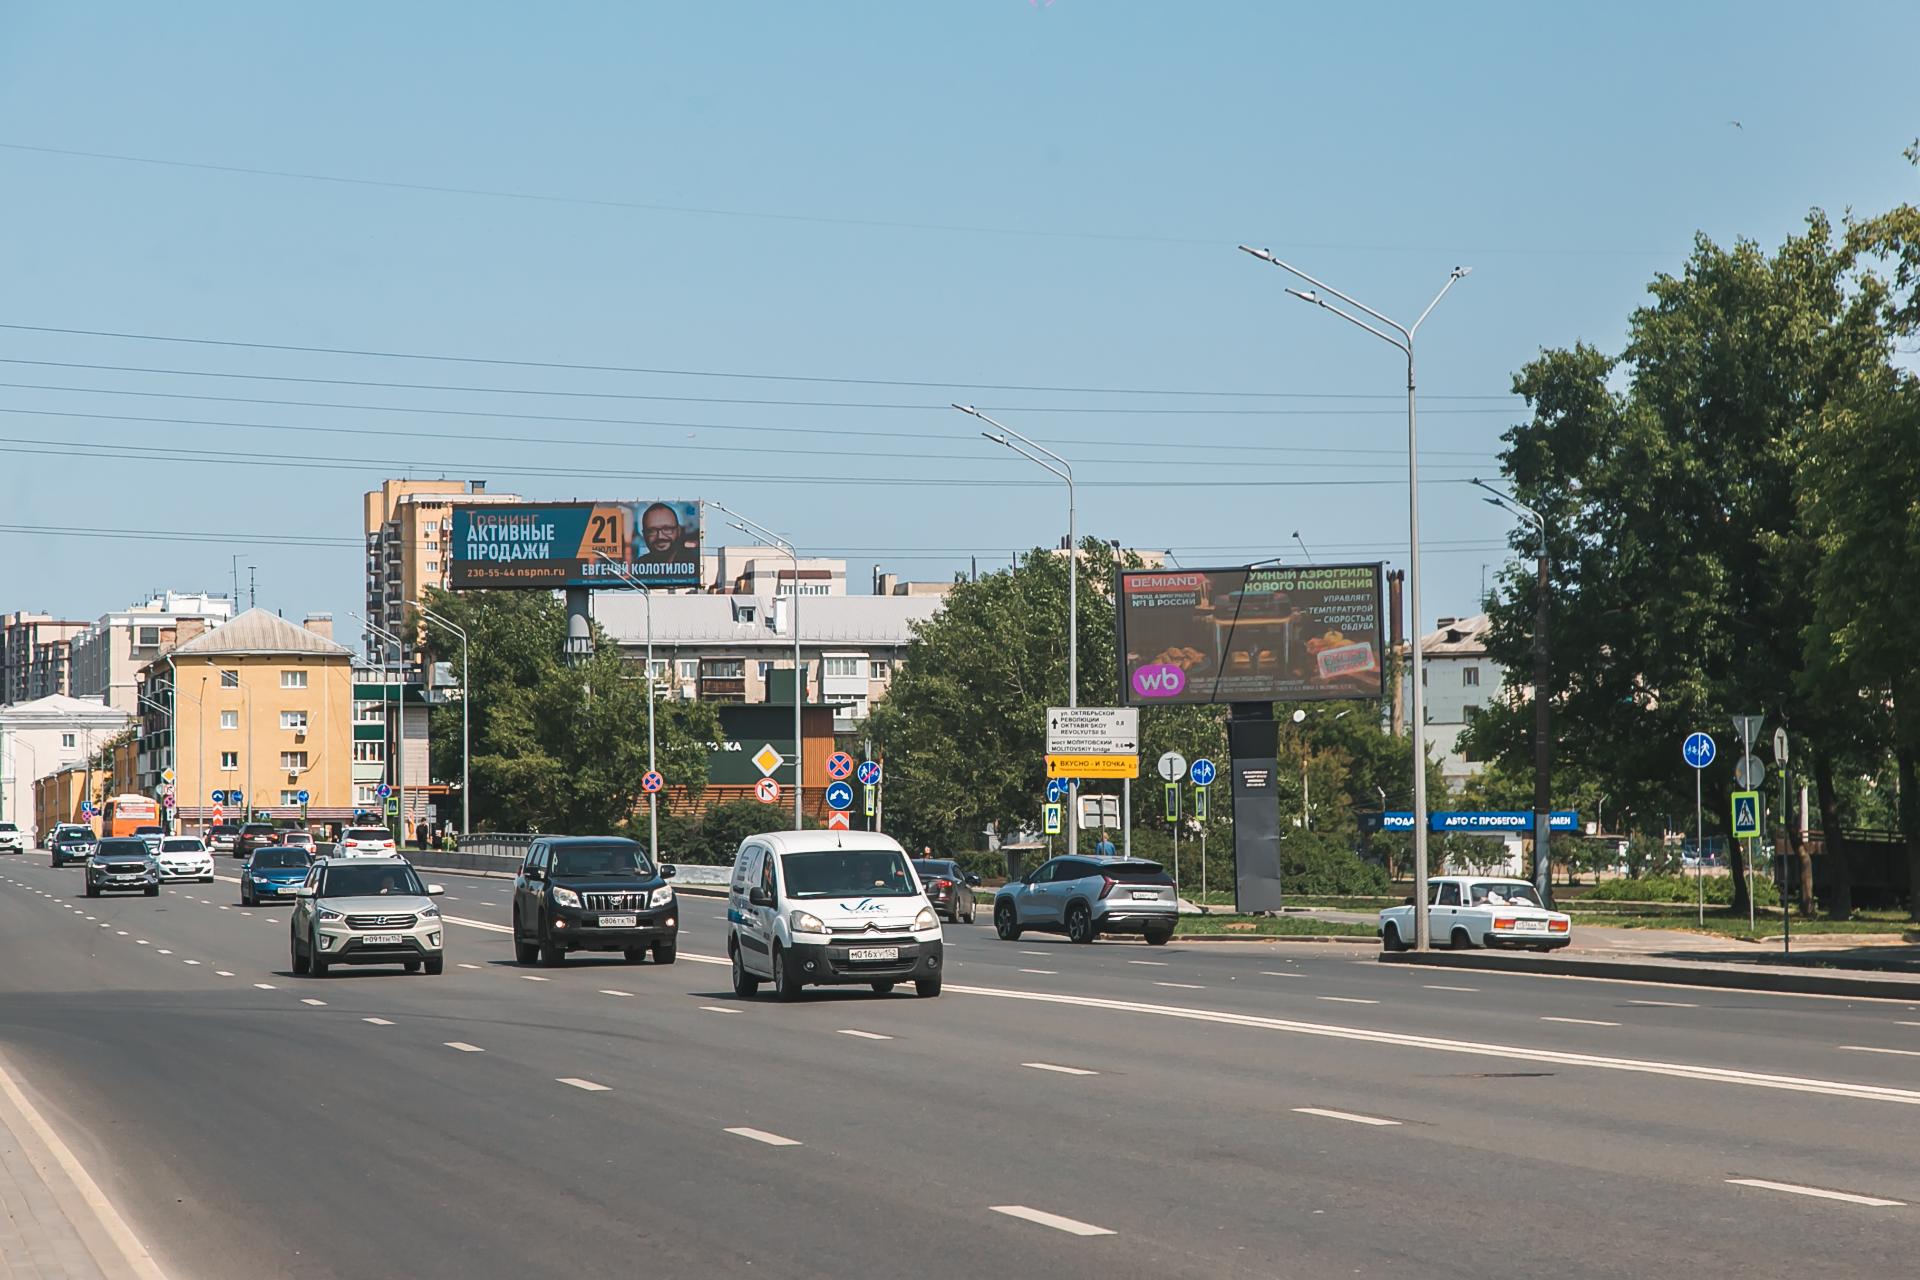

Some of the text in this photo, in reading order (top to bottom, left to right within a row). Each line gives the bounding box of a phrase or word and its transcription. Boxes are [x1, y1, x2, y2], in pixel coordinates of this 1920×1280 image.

[467, 511, 539, 527] Тренинг
[467, 524, 555, 541] АКТИВНЫЕ
[592, 515, 617, 543] 21
[467, 543, 550, 563] ПРОДАЖИ
[467, 568, 565, 578] 230-55-44 nspnn.ru
[631, 563, 695, 575] КОЛОТИЛОВ
[1249, 568, 1373, 580] УМНЫЙ АЭРОГРИЛЬ
[1244, 579, 1373, 592] НОВОГО ПОКОЛЕНИЯ
[1157, 598, 1196, 606] РОССИИ
[1323, 593, 1371, 602] УПРАВЛЯЕТ
[1309, 604, 1373, 615] ТЕМПЕРАТУРОЙ
[1323, 614, 1374, 624] СКОРОСТЬЮ
[1341, 622, 1374, 631] ОБДУВА
[1140, 668, 1179, 690] wb
[1445, 816, 1526, 826] АВТО С ПРОБЕГОМ
